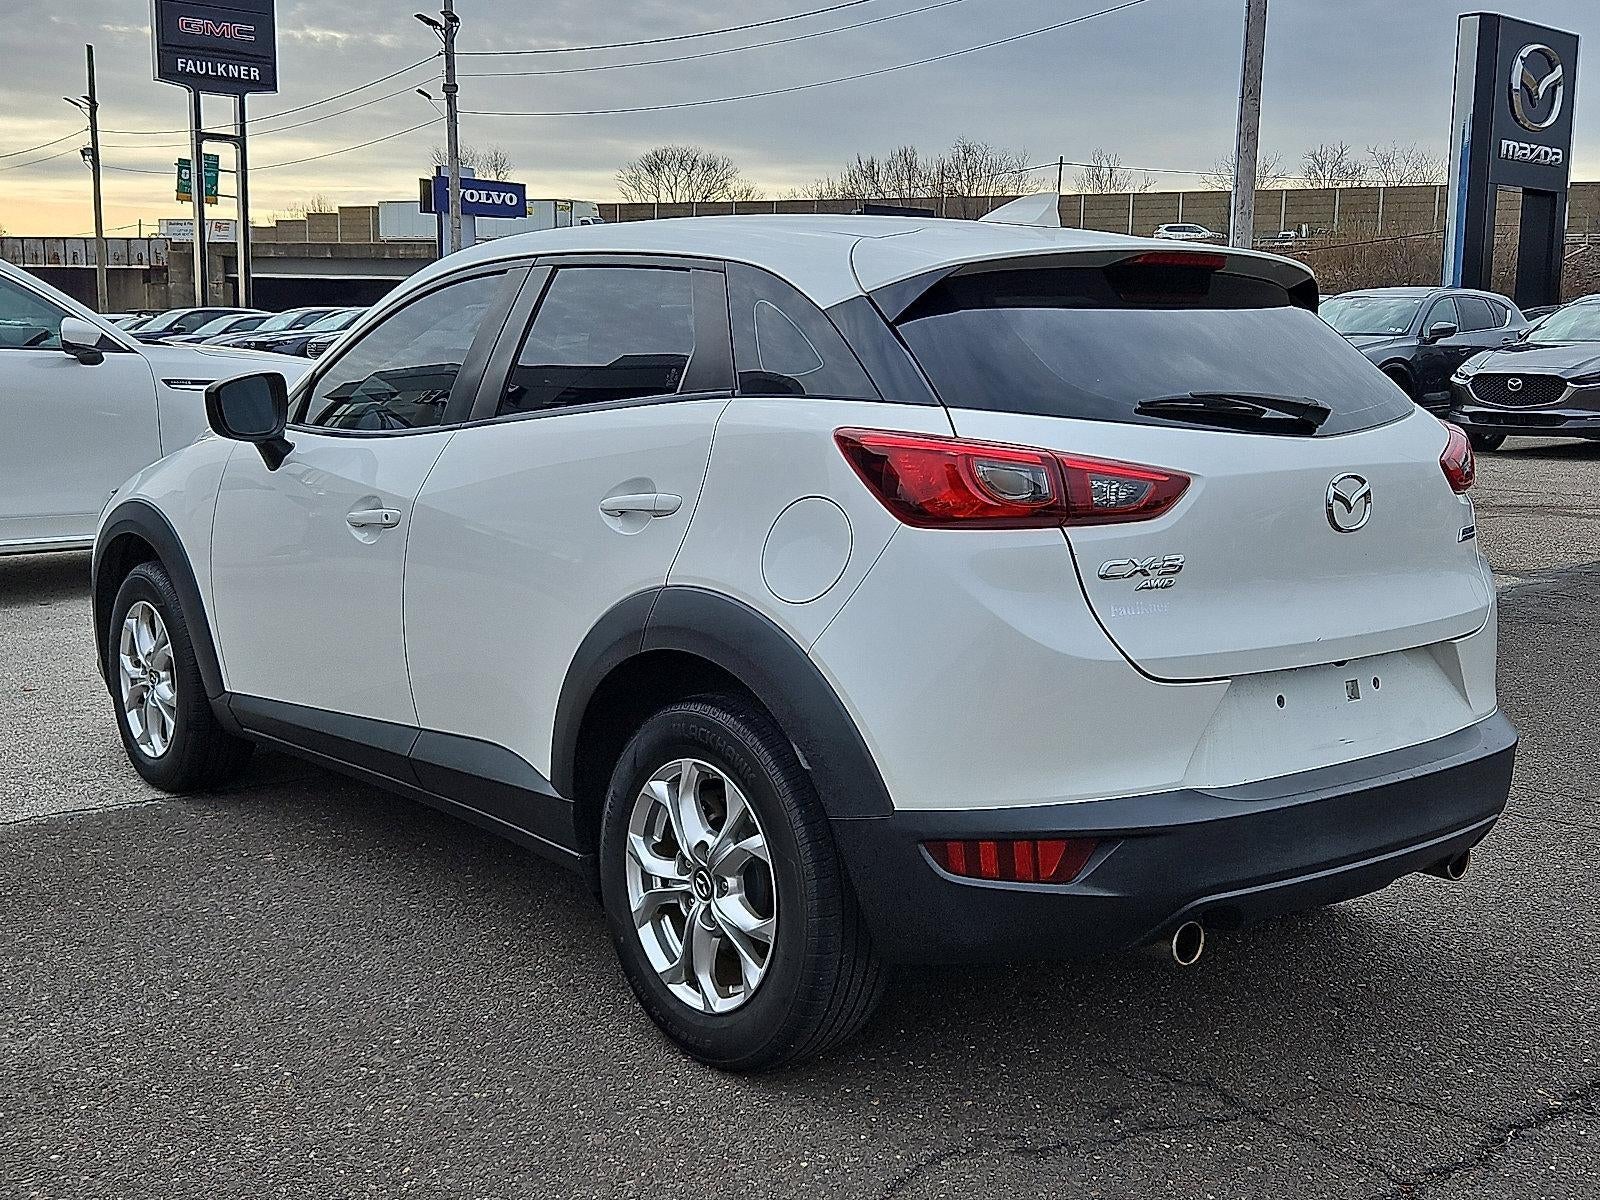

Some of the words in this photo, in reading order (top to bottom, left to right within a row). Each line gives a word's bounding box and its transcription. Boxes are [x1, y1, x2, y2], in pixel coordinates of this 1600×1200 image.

[178, 16, 256, 42] GMC
[177, 58, 260, 81] FAULKNER
[1097, 553, 1185, 580] CX-3
[1134, 577, 1176, 592] AWD
